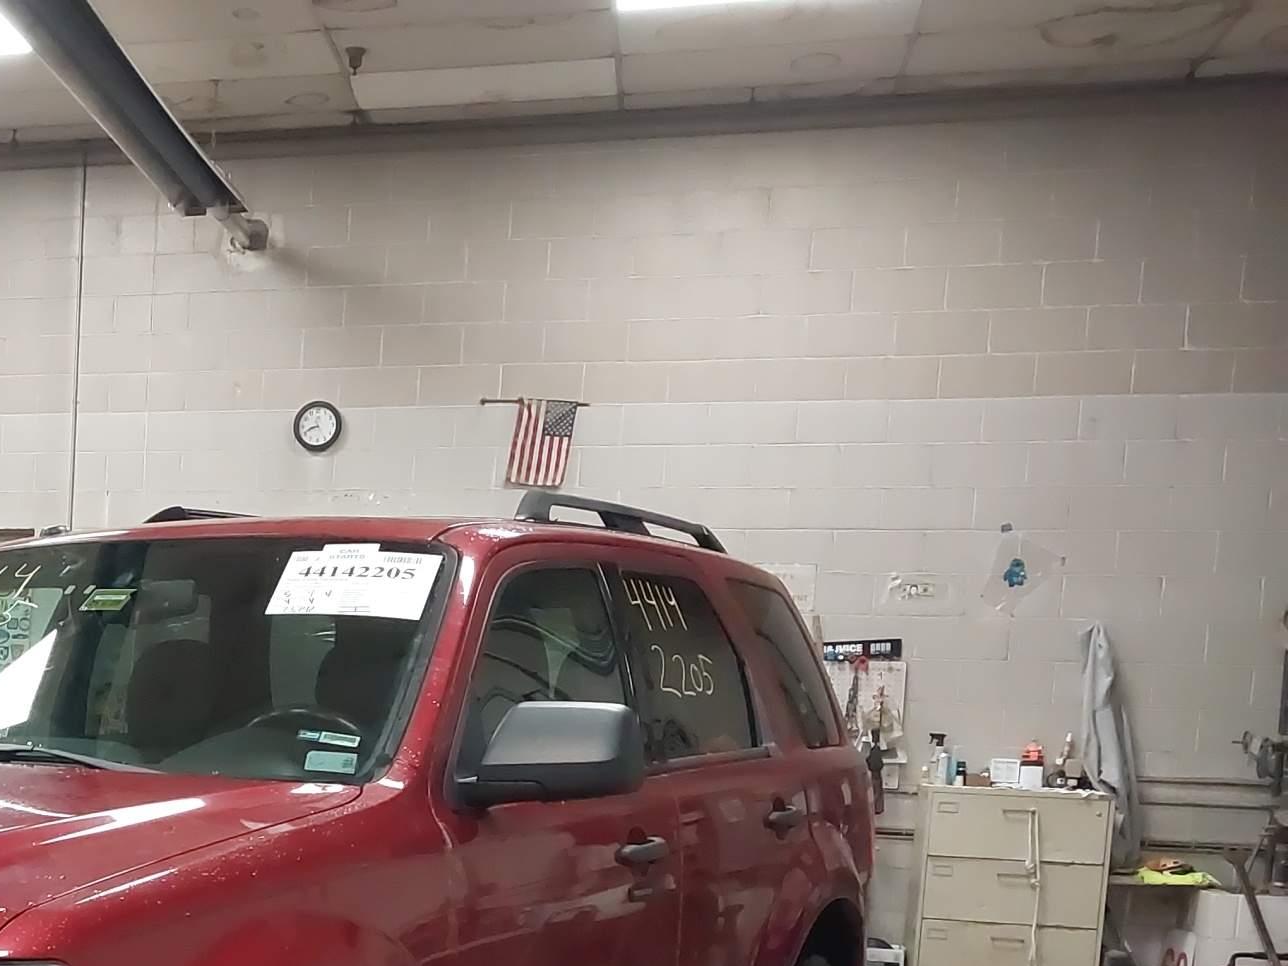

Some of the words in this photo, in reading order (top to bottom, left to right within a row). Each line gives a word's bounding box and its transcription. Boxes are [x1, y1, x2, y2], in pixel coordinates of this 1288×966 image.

[298, 565, 417, 580] 44142205
[622, 578, 689, 632] 4414
[650, 644, 714, 699] 2205
